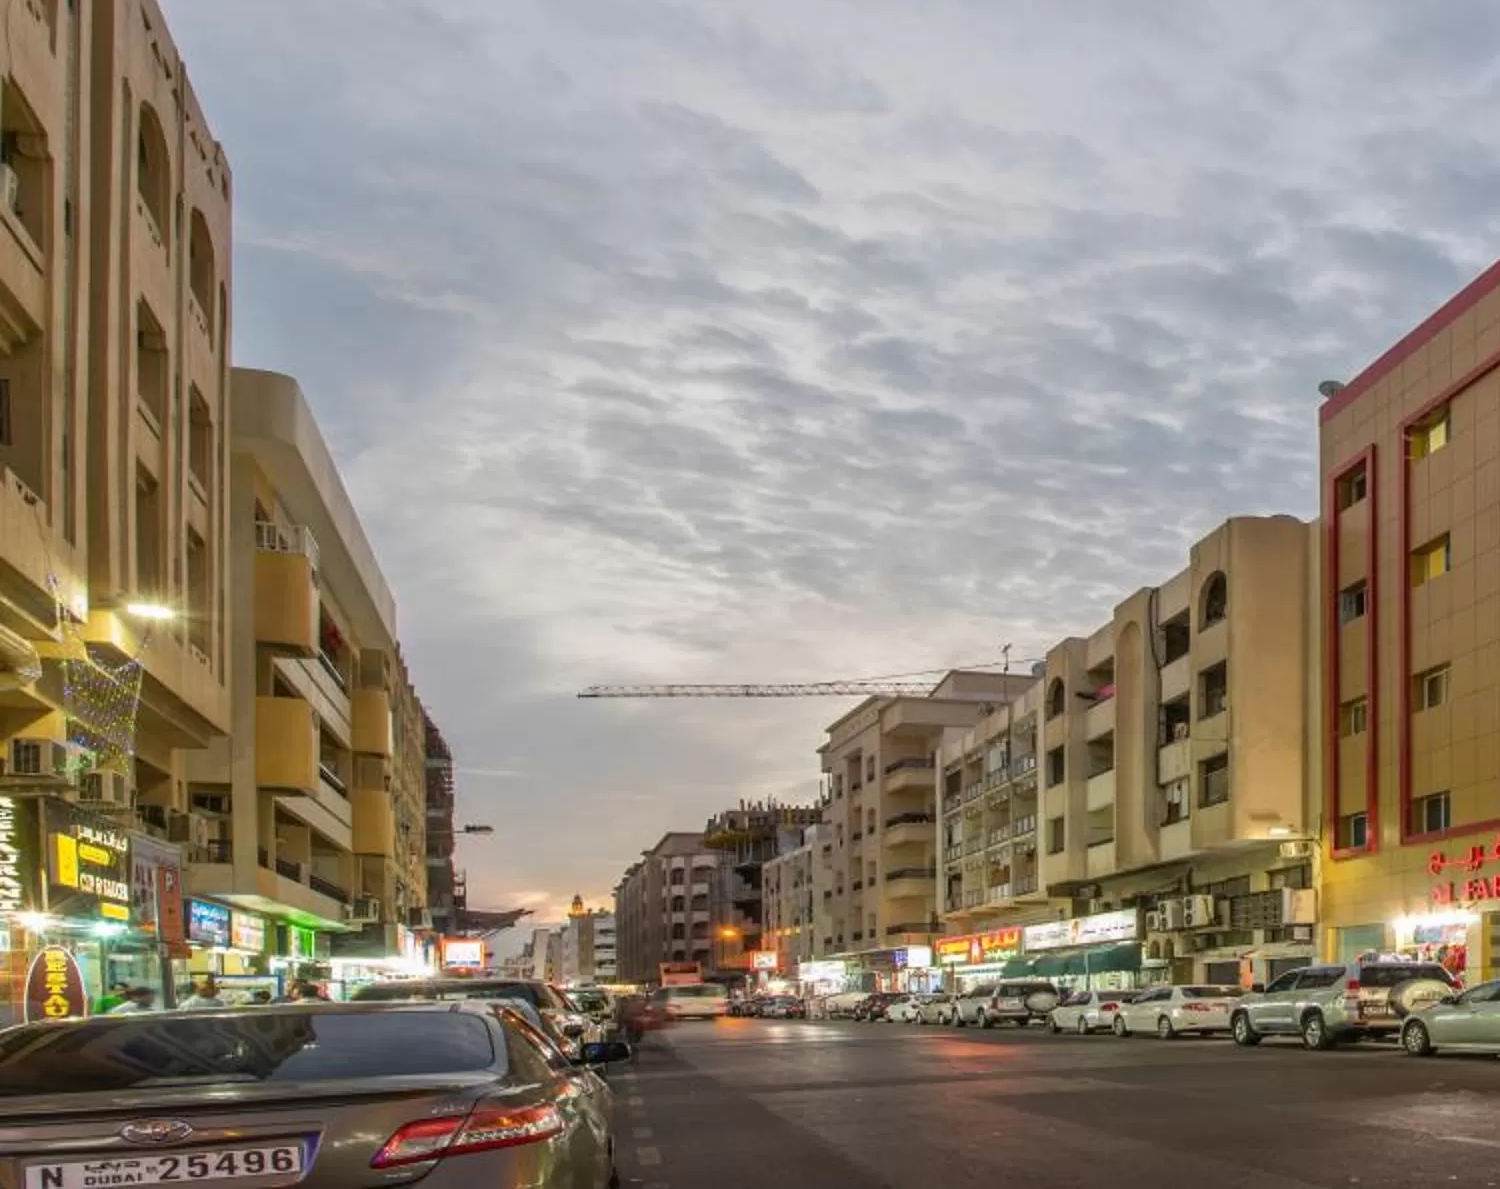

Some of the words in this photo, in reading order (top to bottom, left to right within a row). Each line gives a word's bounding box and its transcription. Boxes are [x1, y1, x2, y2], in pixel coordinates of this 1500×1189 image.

[1431, 881, 1458, 904] AL
[158, 1148, 294, 1181] 25496
[41, 1167, 63, 1189] N
[84, 1172, 142, 1186] DUBAI
